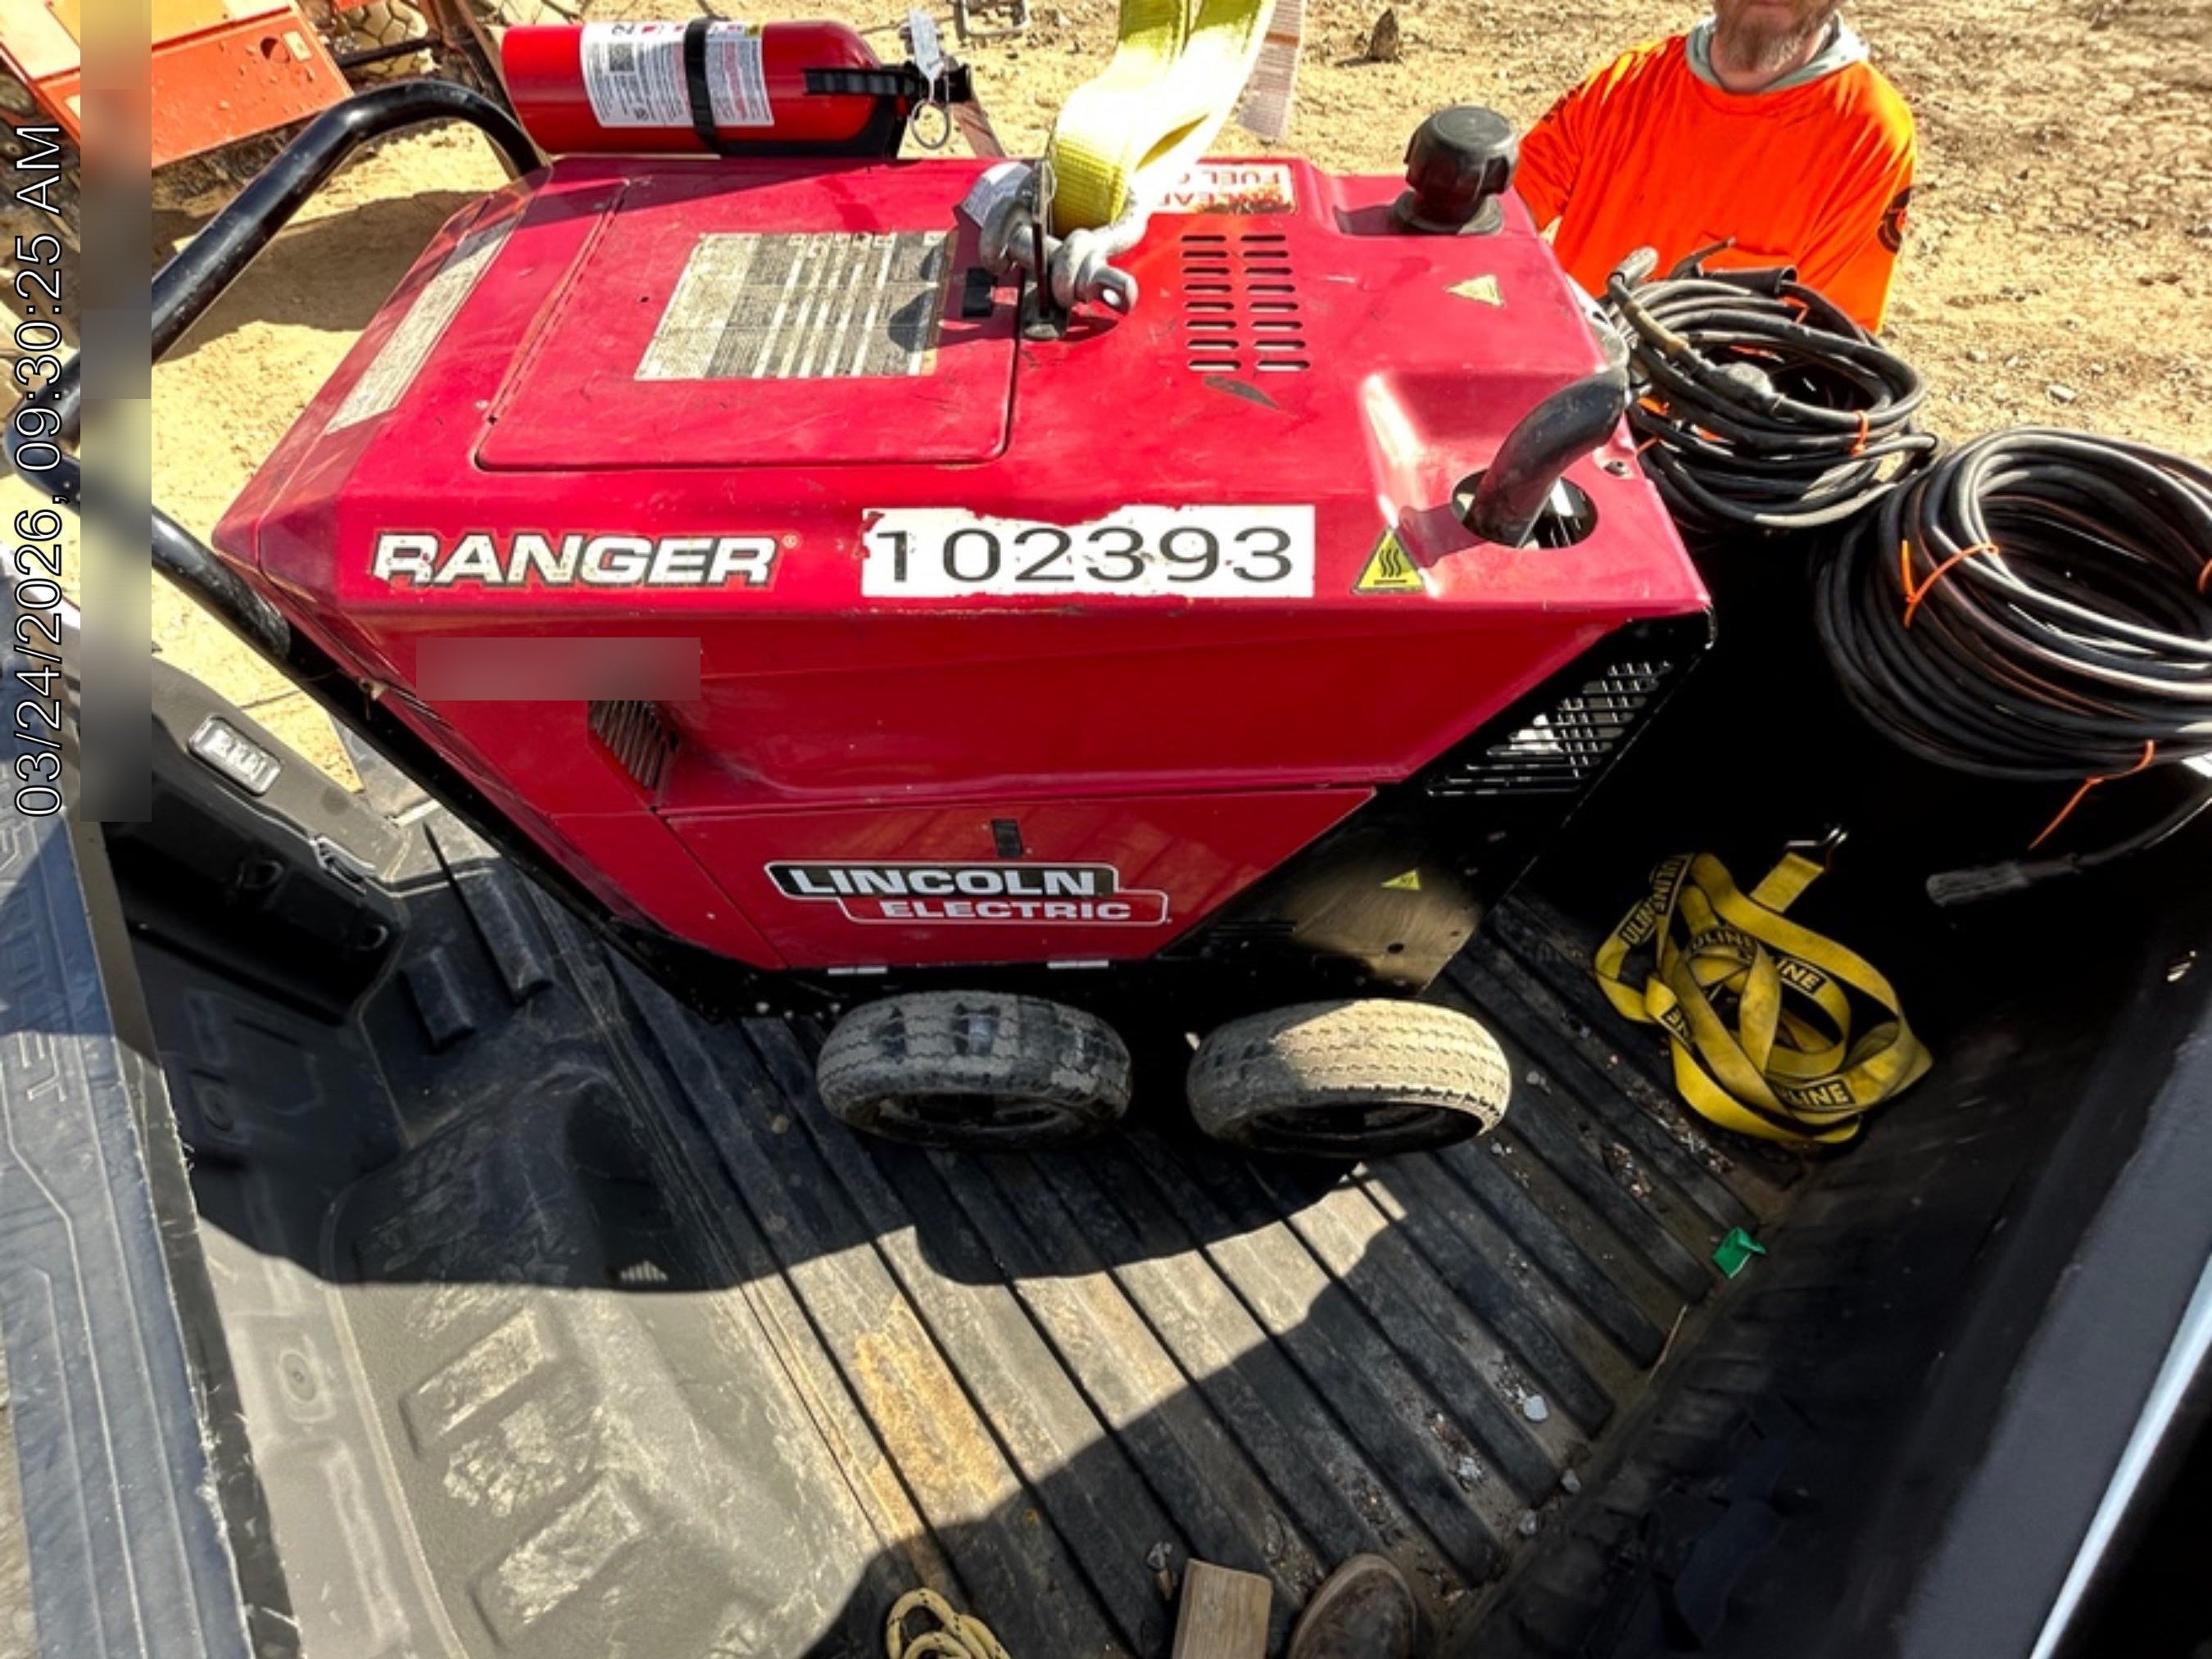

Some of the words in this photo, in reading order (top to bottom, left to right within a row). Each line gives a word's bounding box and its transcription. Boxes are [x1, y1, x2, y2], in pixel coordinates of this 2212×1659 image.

[374, 532, 779, 587] RANGER
[875, 526, 1294, 582] 102393
[788, 868, 1095, 895] LINCOLN
[879, 900, 1131, 920] ELECTRIC
[1621, 901, 1655, 944] ULIN
[1776, 959, 1820, 989] INE
